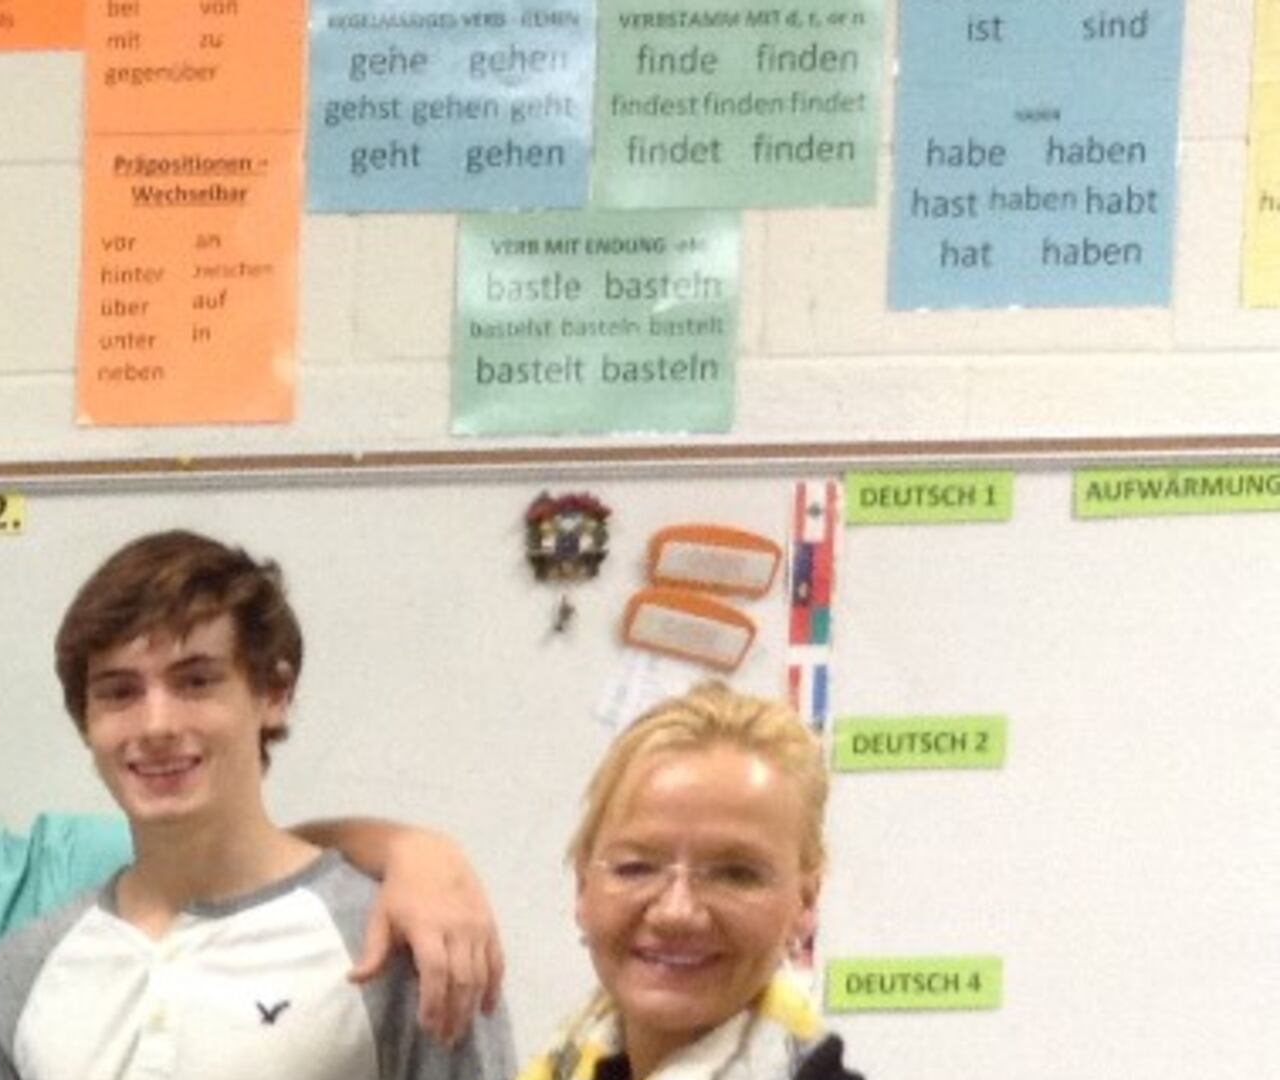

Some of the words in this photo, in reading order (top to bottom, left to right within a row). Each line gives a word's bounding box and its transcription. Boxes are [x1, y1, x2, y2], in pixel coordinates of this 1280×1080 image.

[199, 1, 239, 15] von
[967, 15, 1004, 42] ist
[1083, 10, 1148, 40] sind
[107, 32, 141, 50] mit
[199, 33, 222, 49] zu
[349, 45, 428, 82] gehe
[470, 44, 567, 79] gehen
[637, 43, 718, 75] finde
[756, 42, 858, 72] finden
[324, 95, 400, 127] gehst
[411, 94, 499, 125] gehen
[510, 92, 573, 123] geht
[611, 93, 697, 117] findest
[702, 91, 783, 115] finden
[791, 91, 865, 113] findet
[350, 140, 420, 177] geht
[466, 138, 565, 174] gehen
[629, 135, 722, 165] findet
[754, 133, 855, 163] finden
[926, 138, 1006, 168] habe
[1045, 136, 1146, 165] haben
[911, 189, 978, 219] hast
[989, 186, 1077, 212] haben
[1086, 186, 1158, 216] habt
[101, 236, 136, 251] vor
[196, 234, 221, 248] an
[545, 238, 579, 254] MIT
[585, 237, 666, 254] ENDUNG
[940, 240, 993, 268] hat
[1042, 237, 1142, 266] haben
[101, 266, 164, 284] hinter
[487, 271, 581, 301] bastle
[605, 270, 723, 299] basteln
[192, 289, 227, 310] auf
[98, 332, 156, 350] unter
[192, 324, 211, 342] in
[97, 364, 164, 382] neben
[476, 356, 583, 385] bastelt
[601, 353, 718, 382] basteln
[859, 485, 976, 509] DEUTSCH
[985, 484, 996, 506] 1
[852, 731, 965, 755] DEUTSCH
[974, 731, 989, 753] 2
[845, 972, 960, 995] DEUTSCH
[965, 972, 982, 993] 4
